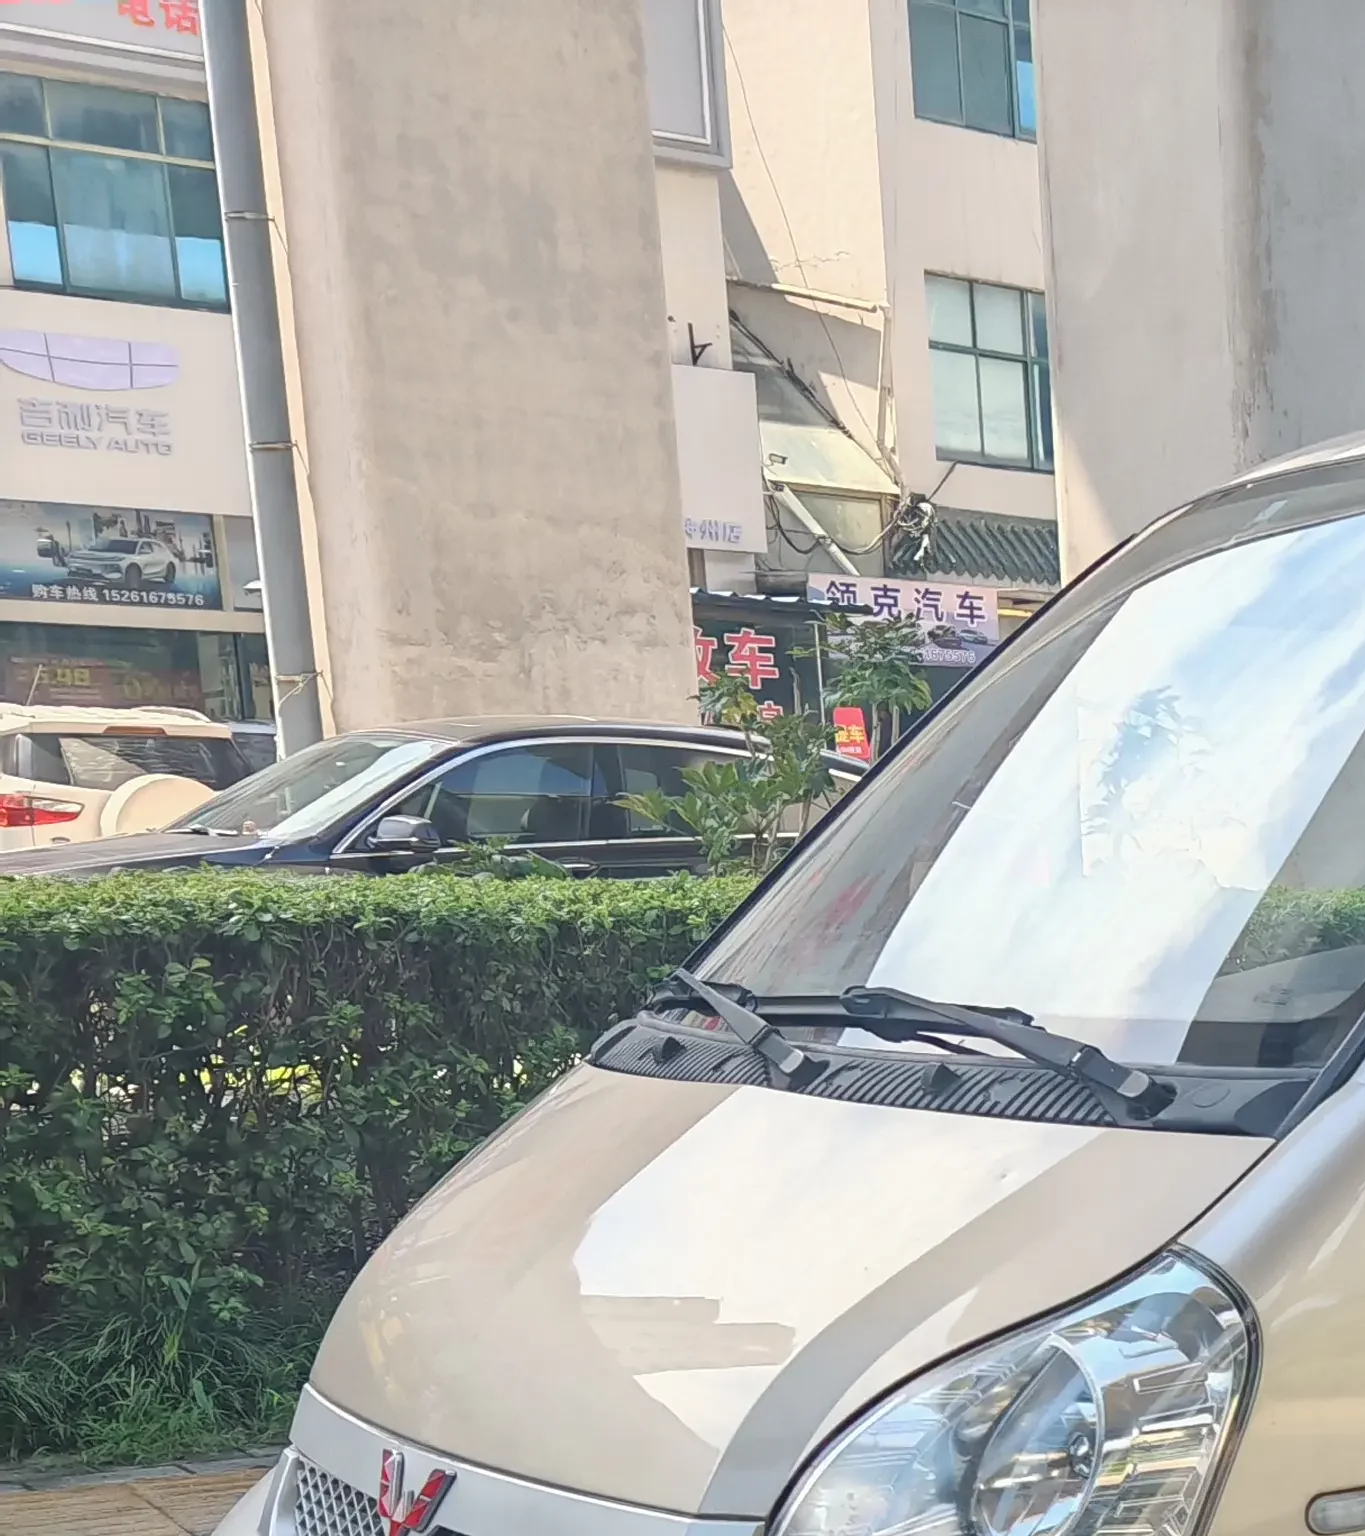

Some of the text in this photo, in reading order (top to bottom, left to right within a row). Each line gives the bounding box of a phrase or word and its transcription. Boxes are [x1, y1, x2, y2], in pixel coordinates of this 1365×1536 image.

[17, 397, 172, 437] 吉利汽车
[21, 431, 172, 456] GEELY AUTO
[31, 583, 99, 602] 购车热线
[826, 579, 987, 627] 领克汽车
